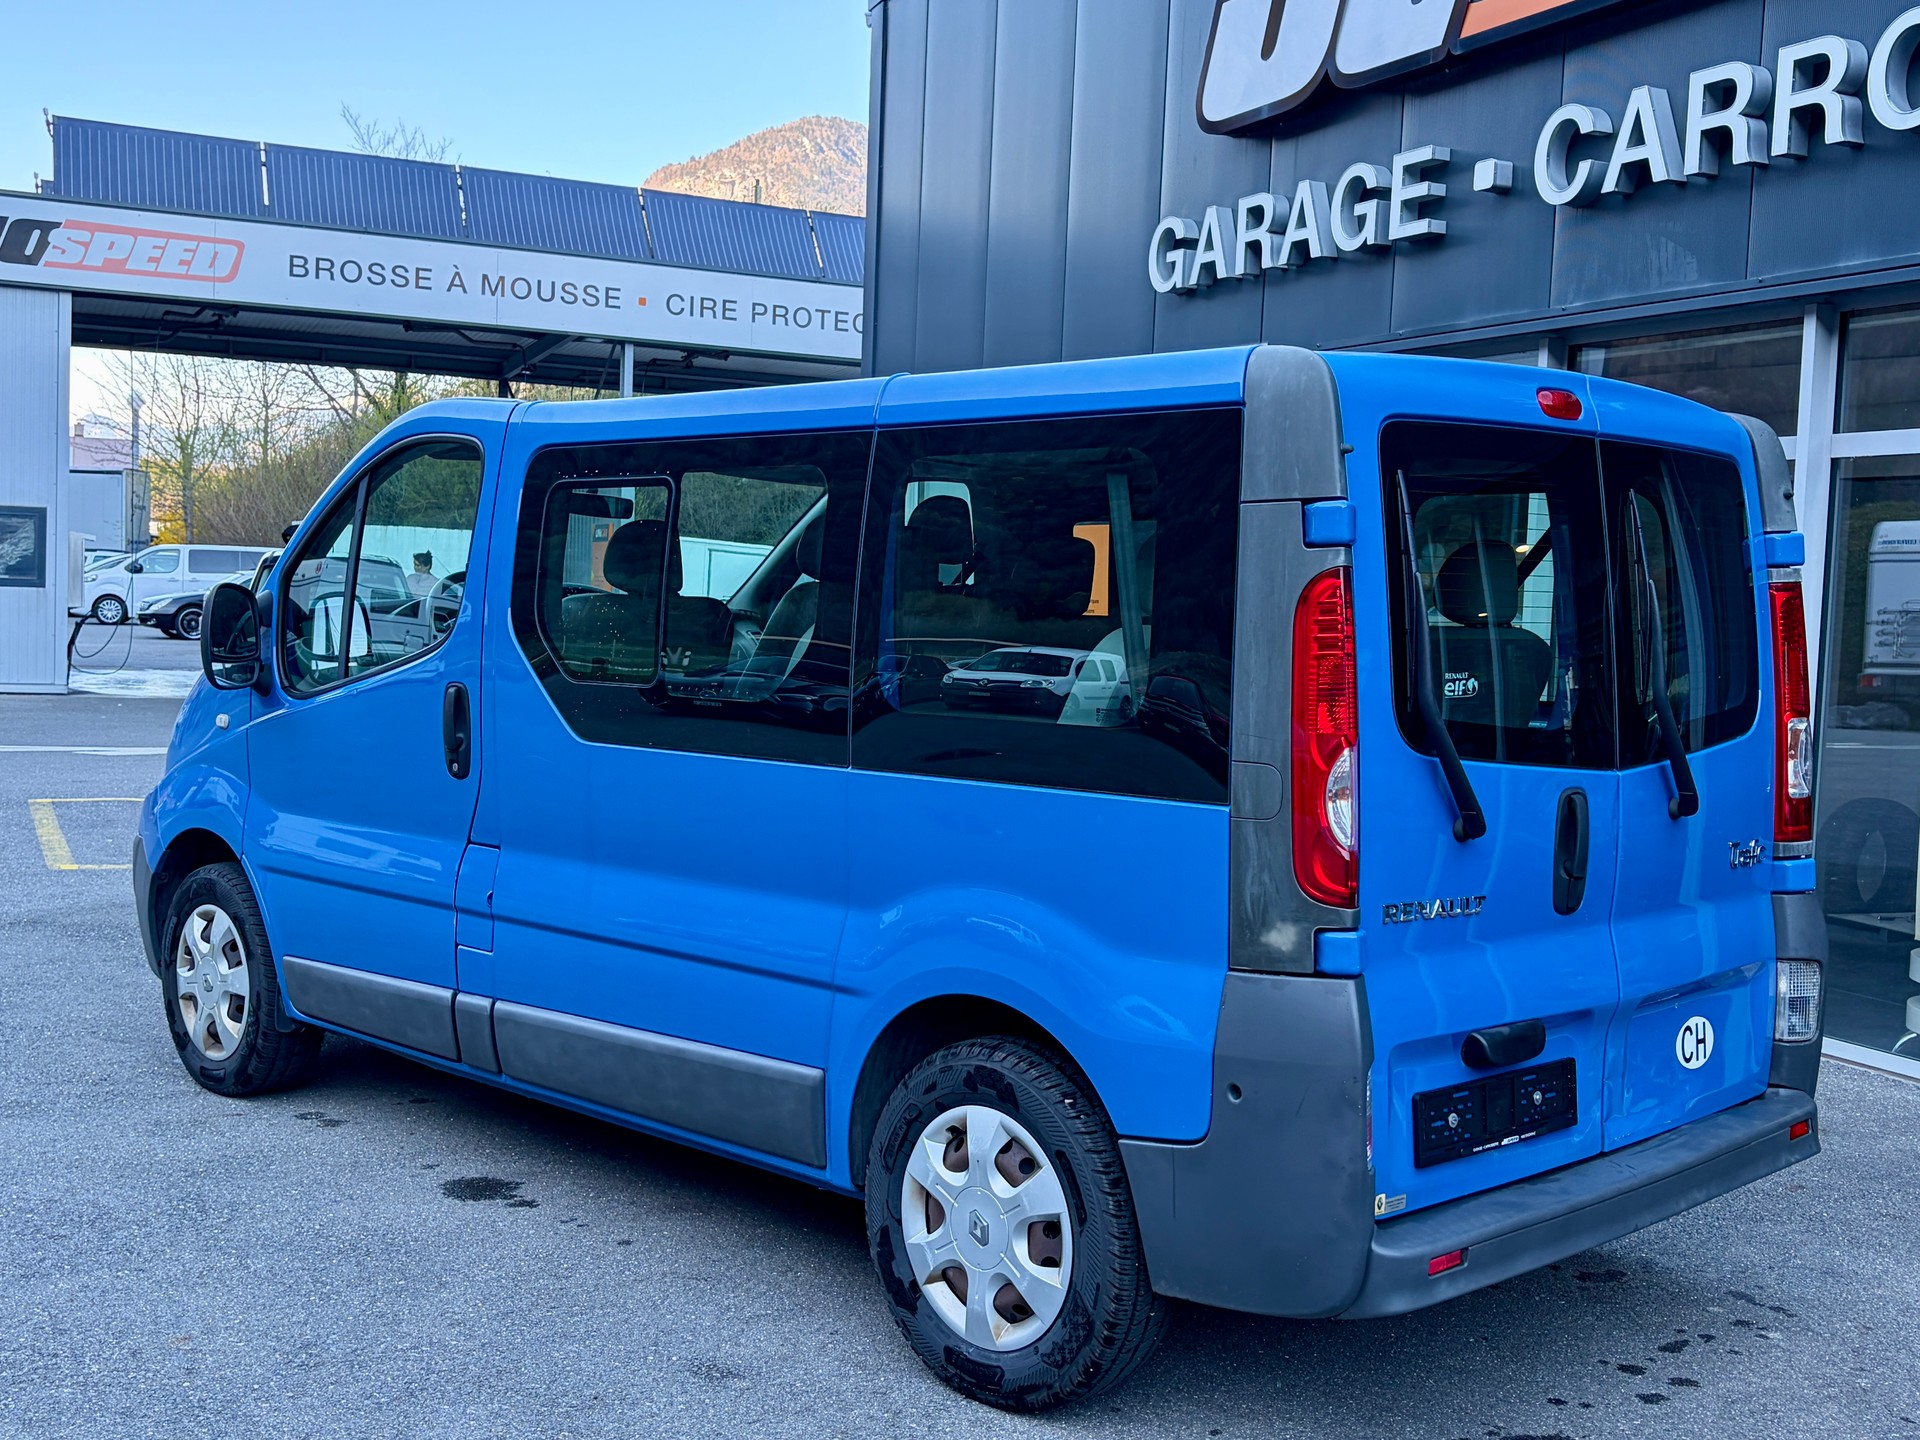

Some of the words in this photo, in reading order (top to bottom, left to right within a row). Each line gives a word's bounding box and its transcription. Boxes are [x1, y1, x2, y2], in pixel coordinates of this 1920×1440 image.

[1149, 145, 1451, 294] GARAGE
[288, 254, 433, 290] BROSSE
[446, 264, 468, 295] À
[481, 273, 622, 310] MOUSSE
[665, 293, 738, 321] CIRE
[1444, 680, 1467, 696] elf
[1382, 895, 1487, 925] RENAULT
[1681, 1021, 1708, 1063] CH
